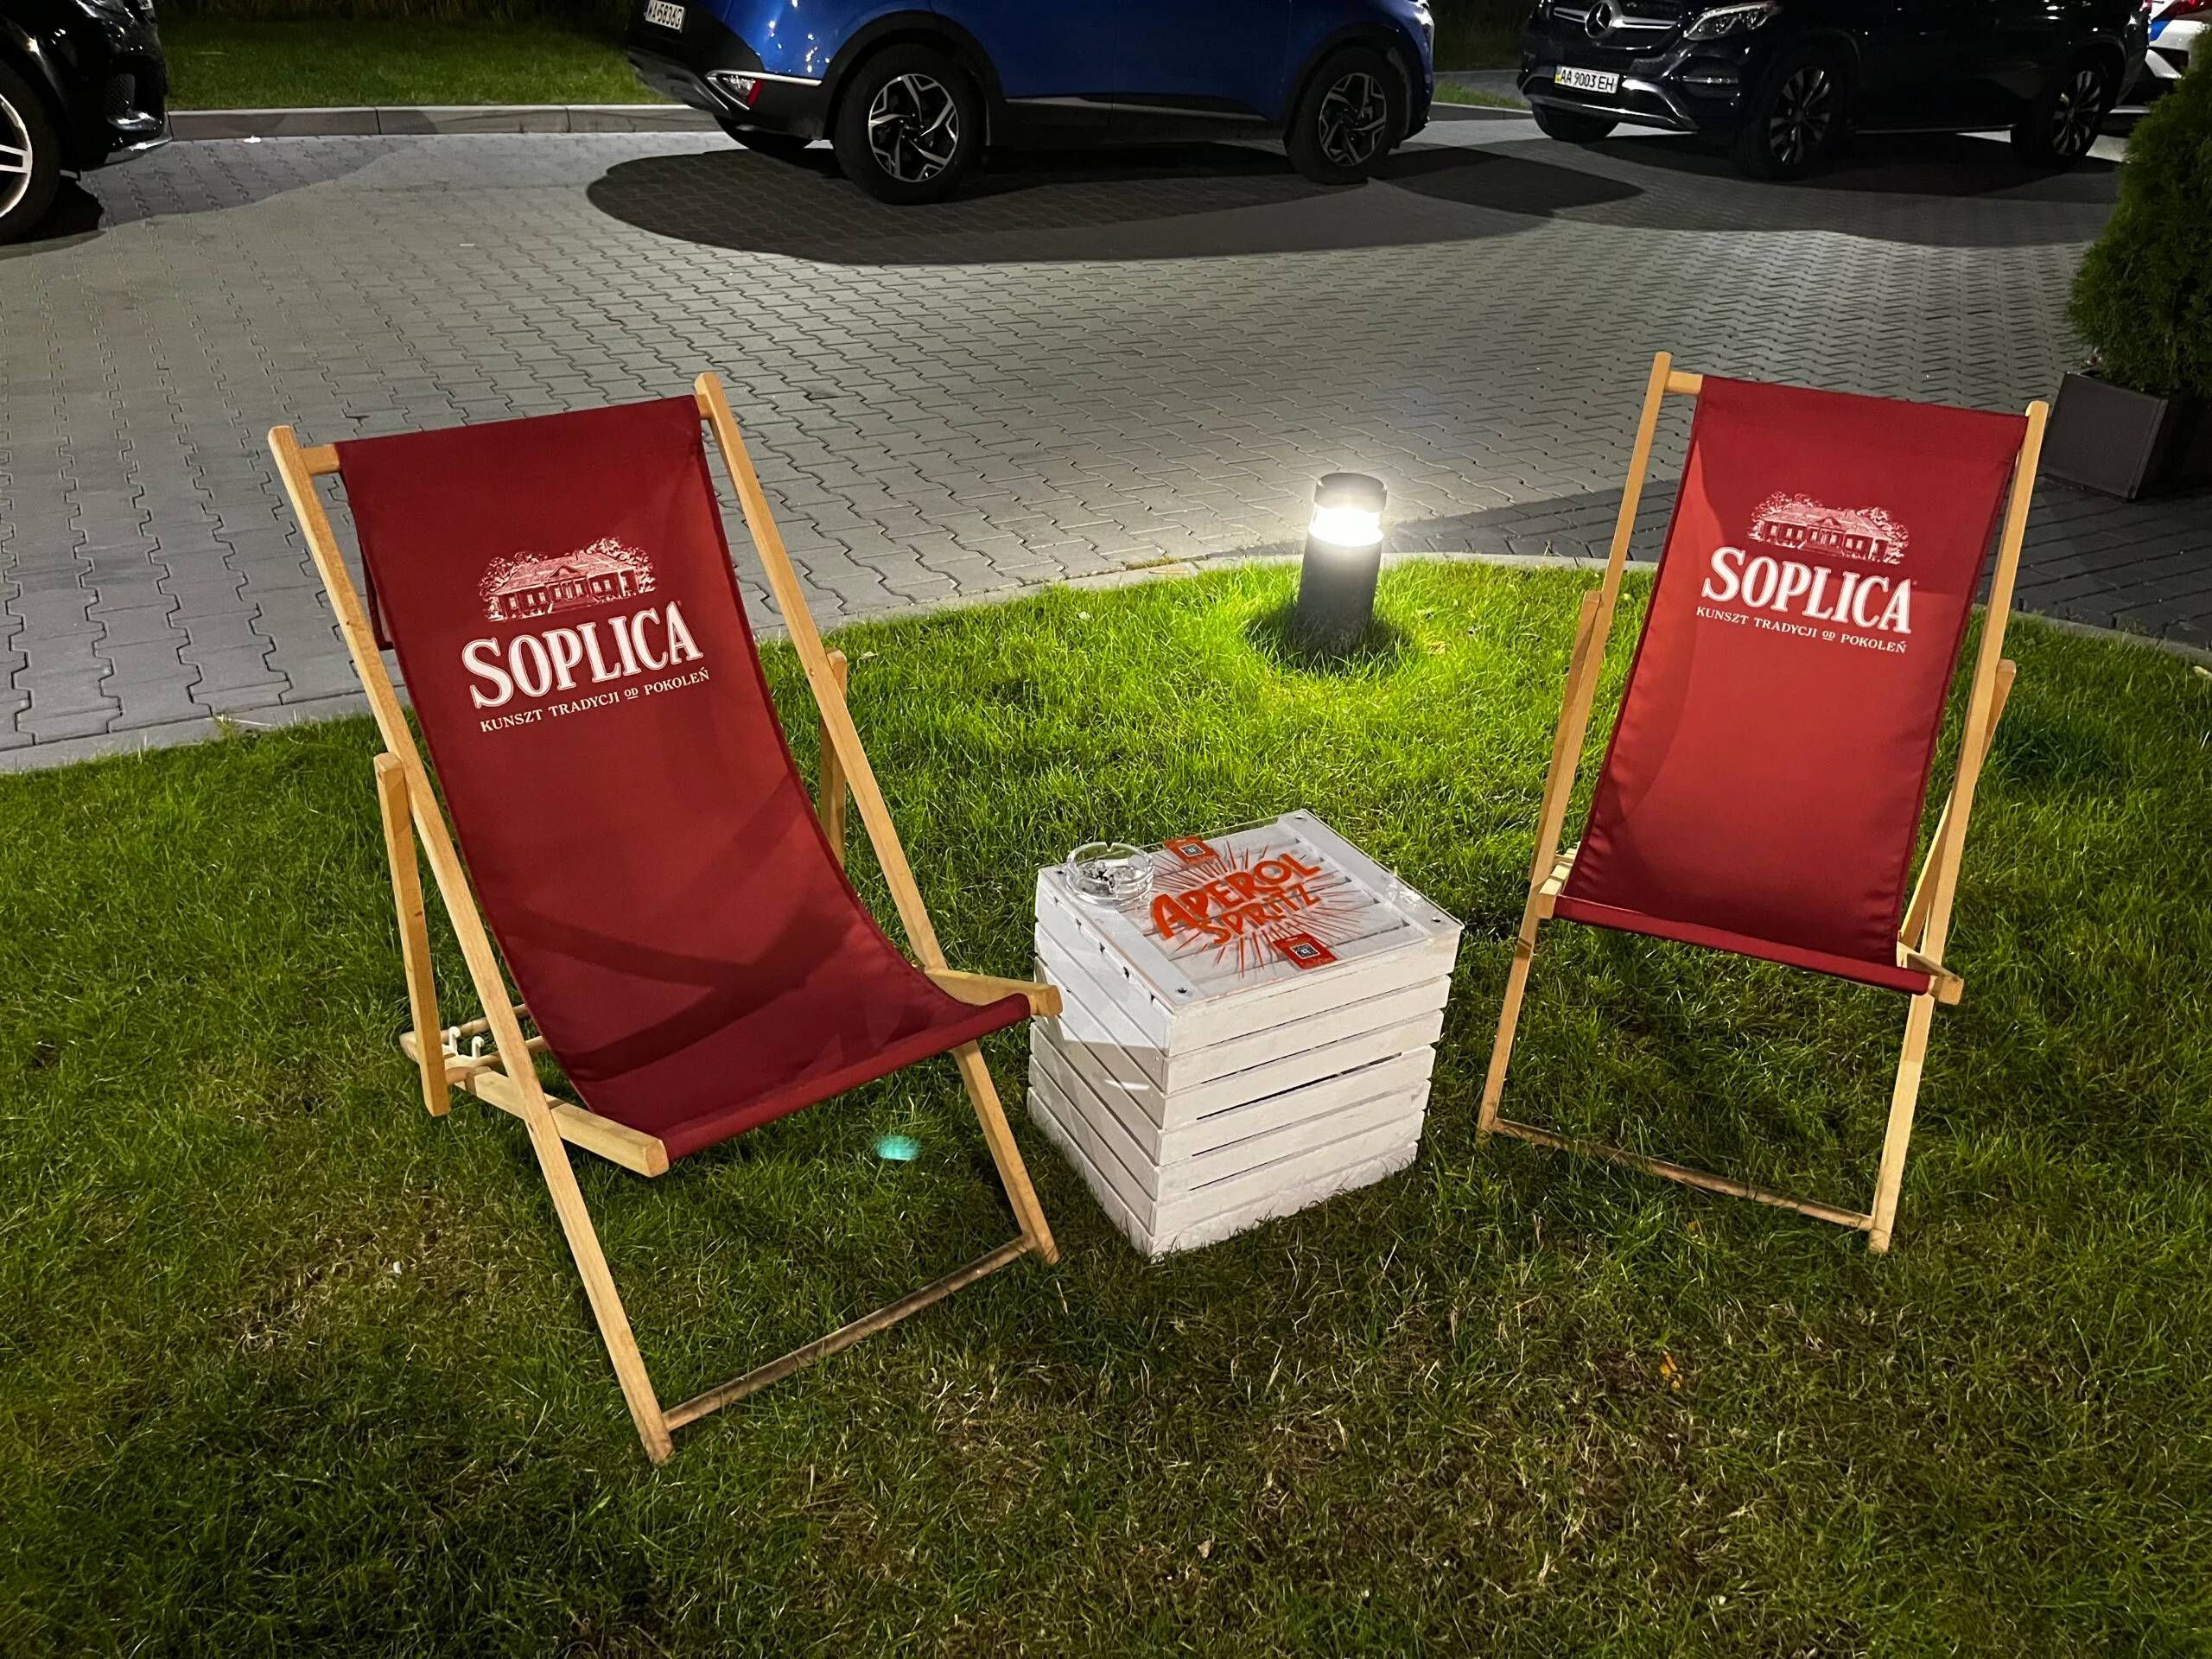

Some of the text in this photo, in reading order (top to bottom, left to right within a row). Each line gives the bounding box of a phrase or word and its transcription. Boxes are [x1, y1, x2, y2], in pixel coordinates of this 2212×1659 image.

[1560, 69, 1615, 91] AA 9003 EH
[1701, 547, 1912, 634] SOPLICA
[462, 601, 703, 709] SOPLICA
[1696, 606, 1907, 654] KUNSZT TRADYCJI OD POKOLEŃ
[480, 666, 710, 732] KUNSZT TRADYCJI OD POKOLEŃ
[1152, 853, 1322, 939] APEROL
